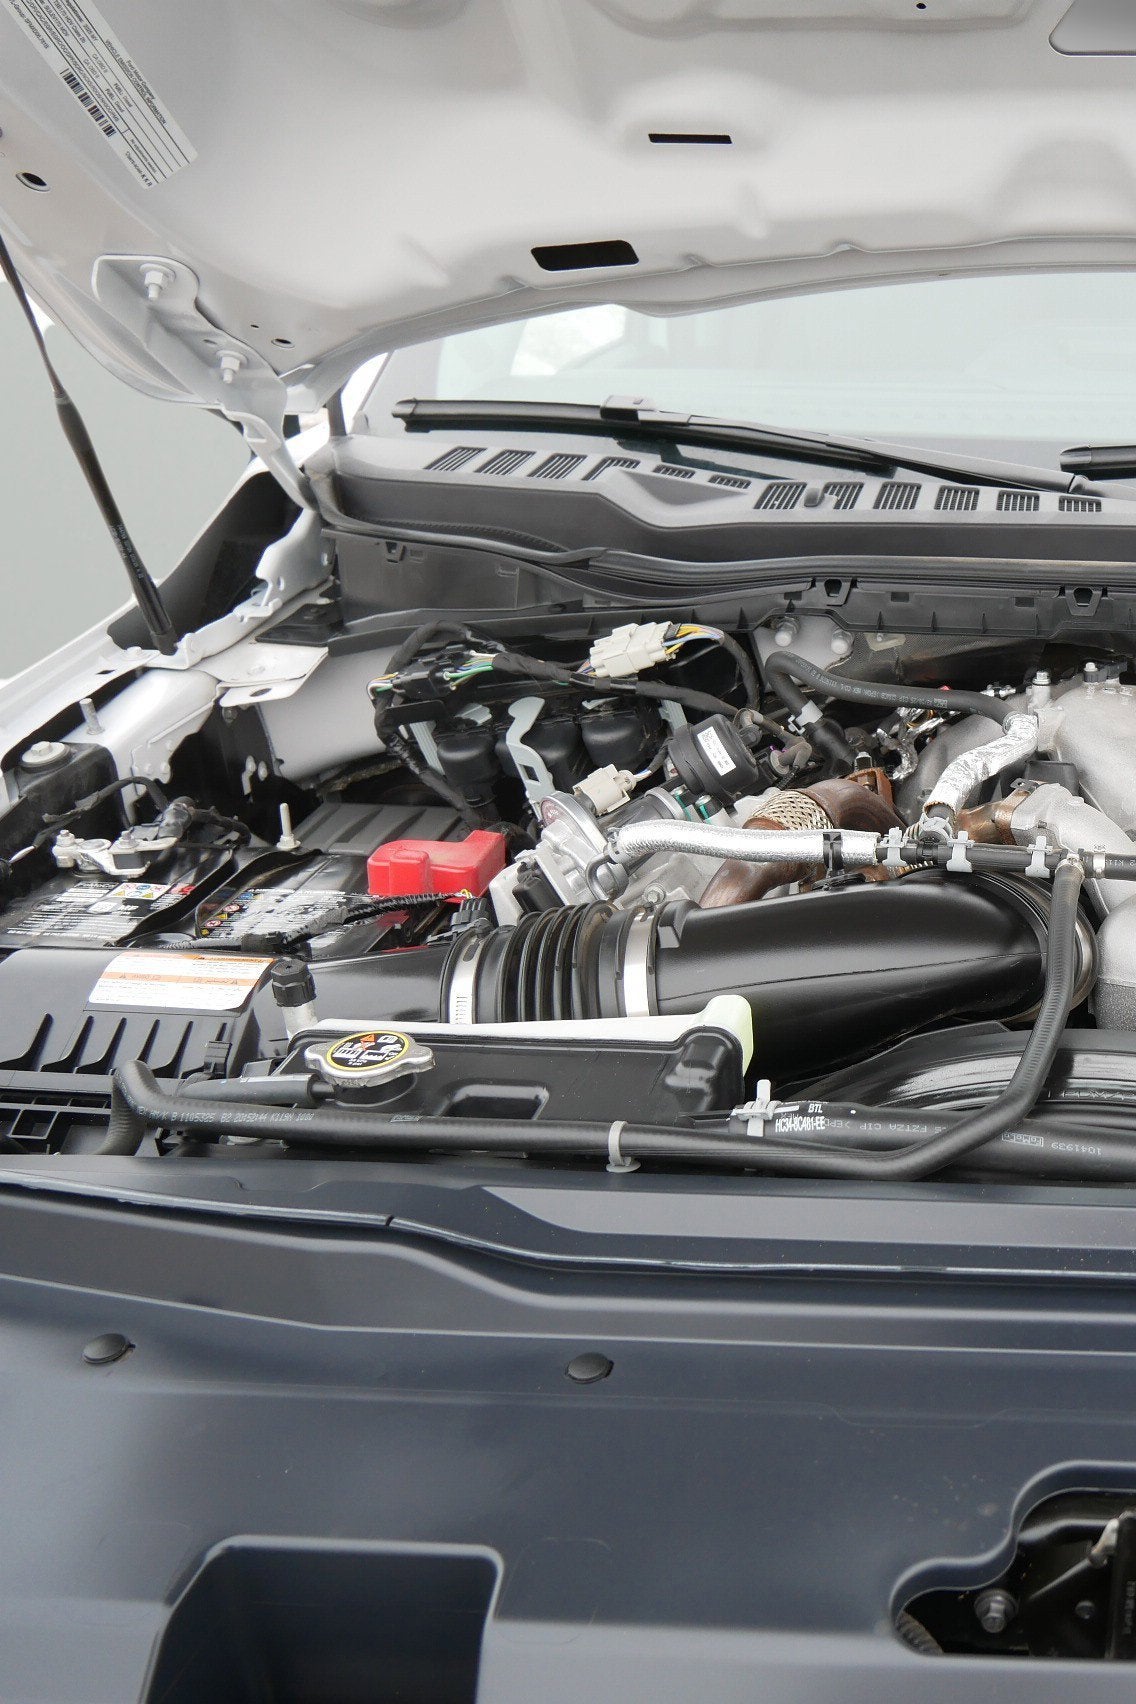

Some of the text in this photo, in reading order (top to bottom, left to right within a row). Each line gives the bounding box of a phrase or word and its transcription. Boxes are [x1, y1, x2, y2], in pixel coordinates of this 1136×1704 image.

[64, 0, 83, 22] egulations:
[104, 39, 167, 124] VEHICLE EMISSION CONTROL INFORMATION
[125, 59, 156, 100] Ford Motor Company
[807, 1103, 823, 1113] BTL
[1050, 1141, 1102, 1155] 1041939
